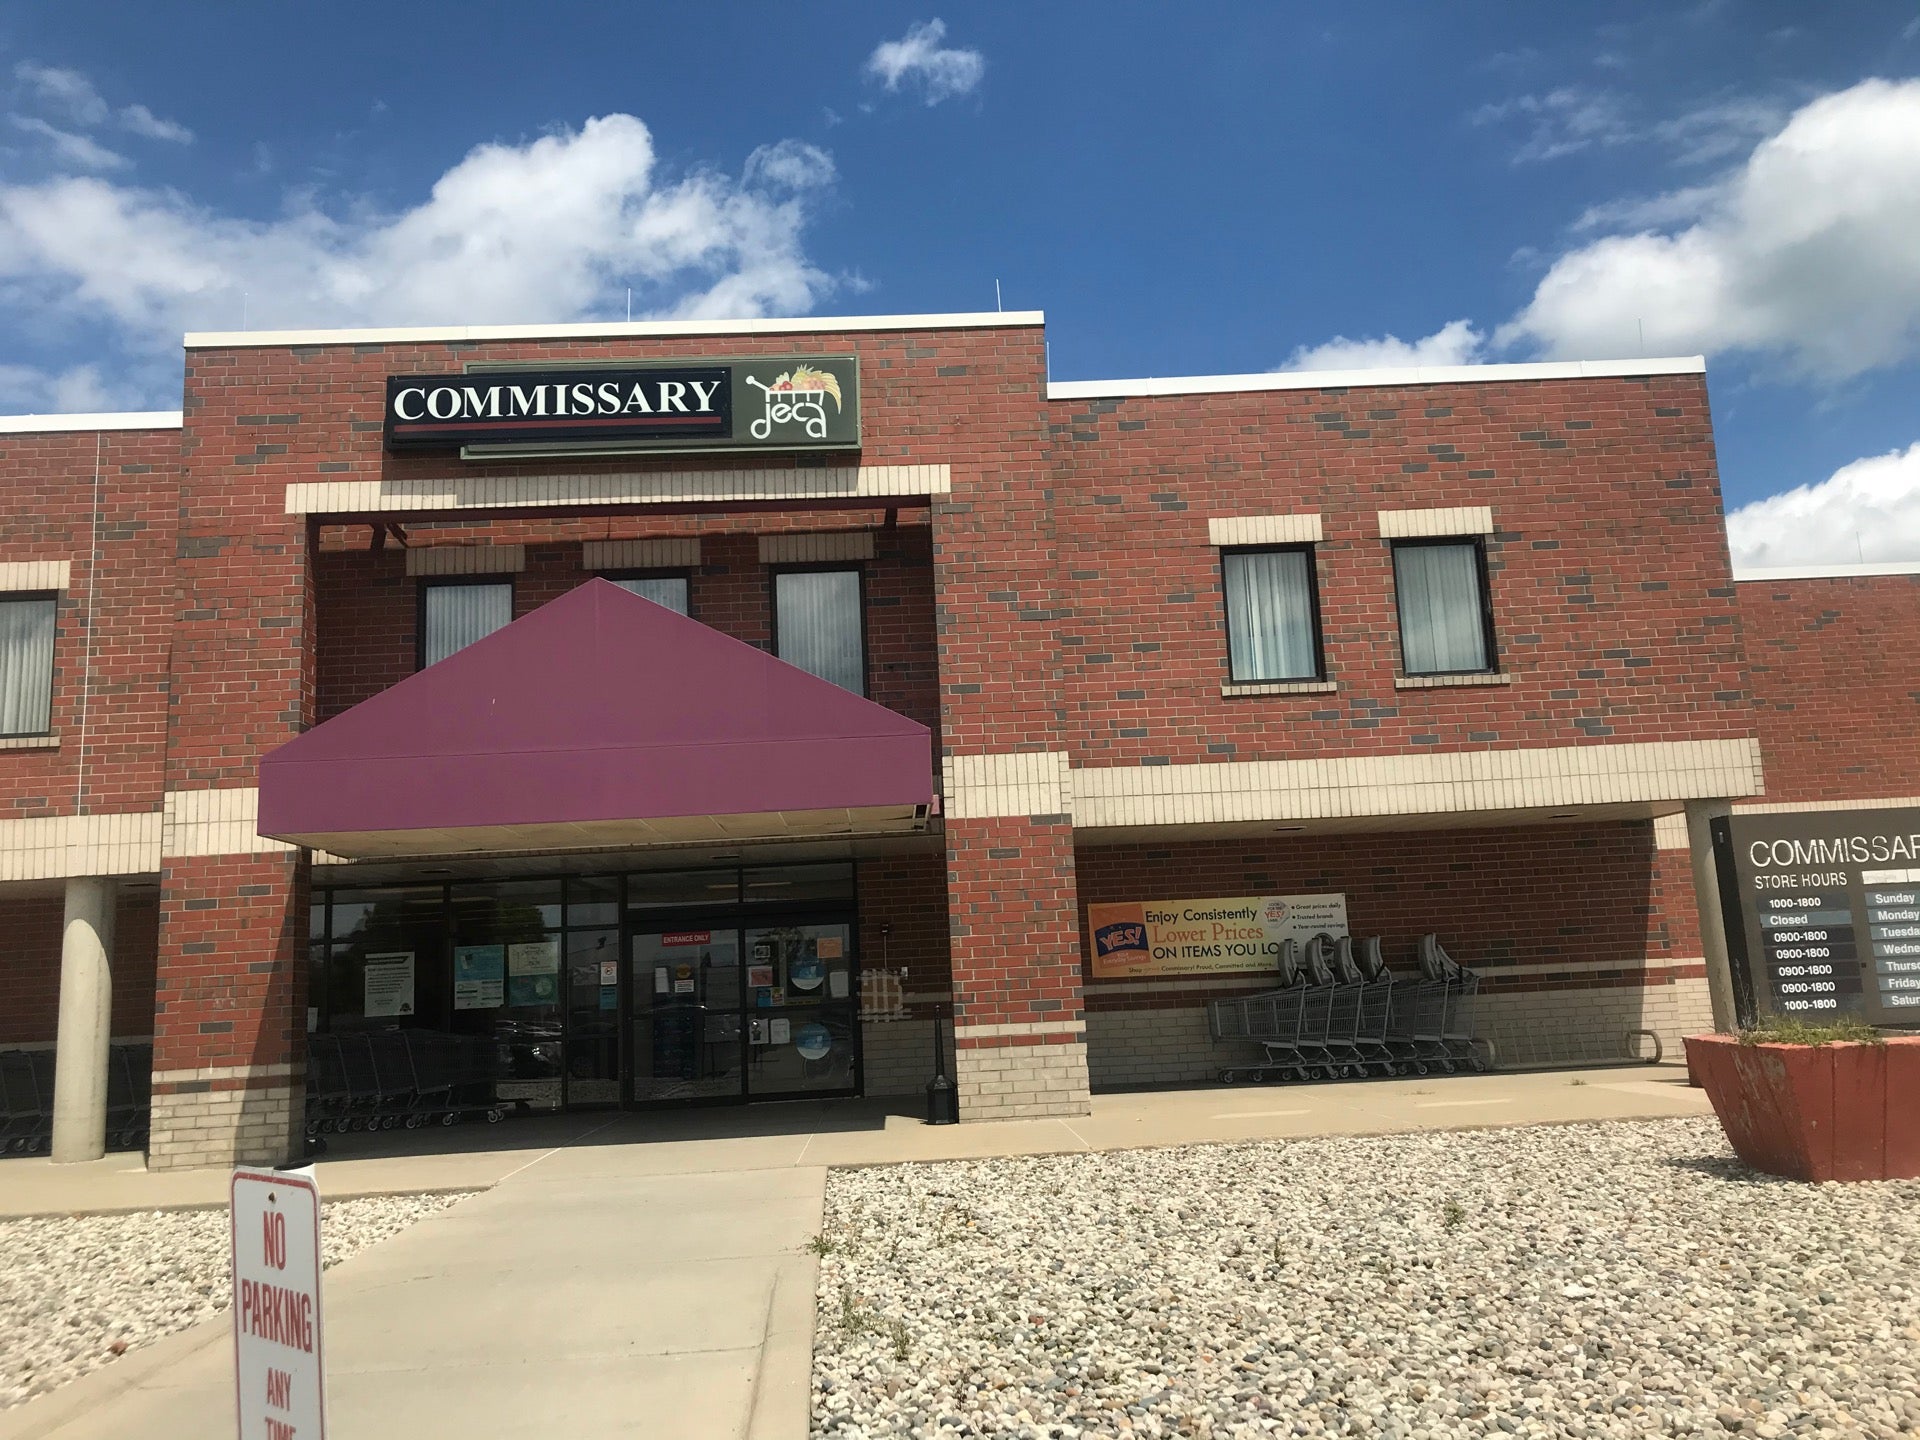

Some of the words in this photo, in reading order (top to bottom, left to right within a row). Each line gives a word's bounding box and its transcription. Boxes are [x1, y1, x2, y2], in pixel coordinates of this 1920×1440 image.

[394, 380, 722, 421] COMMISSARY
[1755, 874, 1798, 889] STORE
[1801, 872, 1848, 887] HOURS
[1769, 897, 1821, 909] 1000-1800
[1875, 893, 1915, 904] Sunday
[1312, 903, 1328, 911] prices
[1145, 909, 1179, 925] Enjoy
[1183, 907, 1258, 922] Consistently
[1769, 914, 1808, 926] Closed
[1877, 909, 1920, 921] Monday
[663, 935, 694, 944] ENTRANCE
[694, 933, 710, 942] ONLY
[1099, 926, 1143, 951] YES!
[1152, 925, 1207, 944] Lower
[1212, 921, 1264, 941] Prices
[1774, 930, 1828, 942] 0900-1800
[1152, 946, 1177, 960] ON
[1181, 944, 1222, 958] ITEMS
[1225, 942, 1257, 957] YOU
[1776, 947, 1830, 959] 0900-1800
[1161, 965, 1195, 973] Commissary!
[1215, 962, 1244, 970] Committed
[1778, 964, 1832, 976] 0900-1800
[1781, 981, 1836, 993] 0900-1800
[1784, 998, 1837, 1010] 1000-1800
[263, 1210, 286, 1271] NO
[242, 1278, 313, 1353] PARKING
[267, 1367, 291, 1412] ANY
